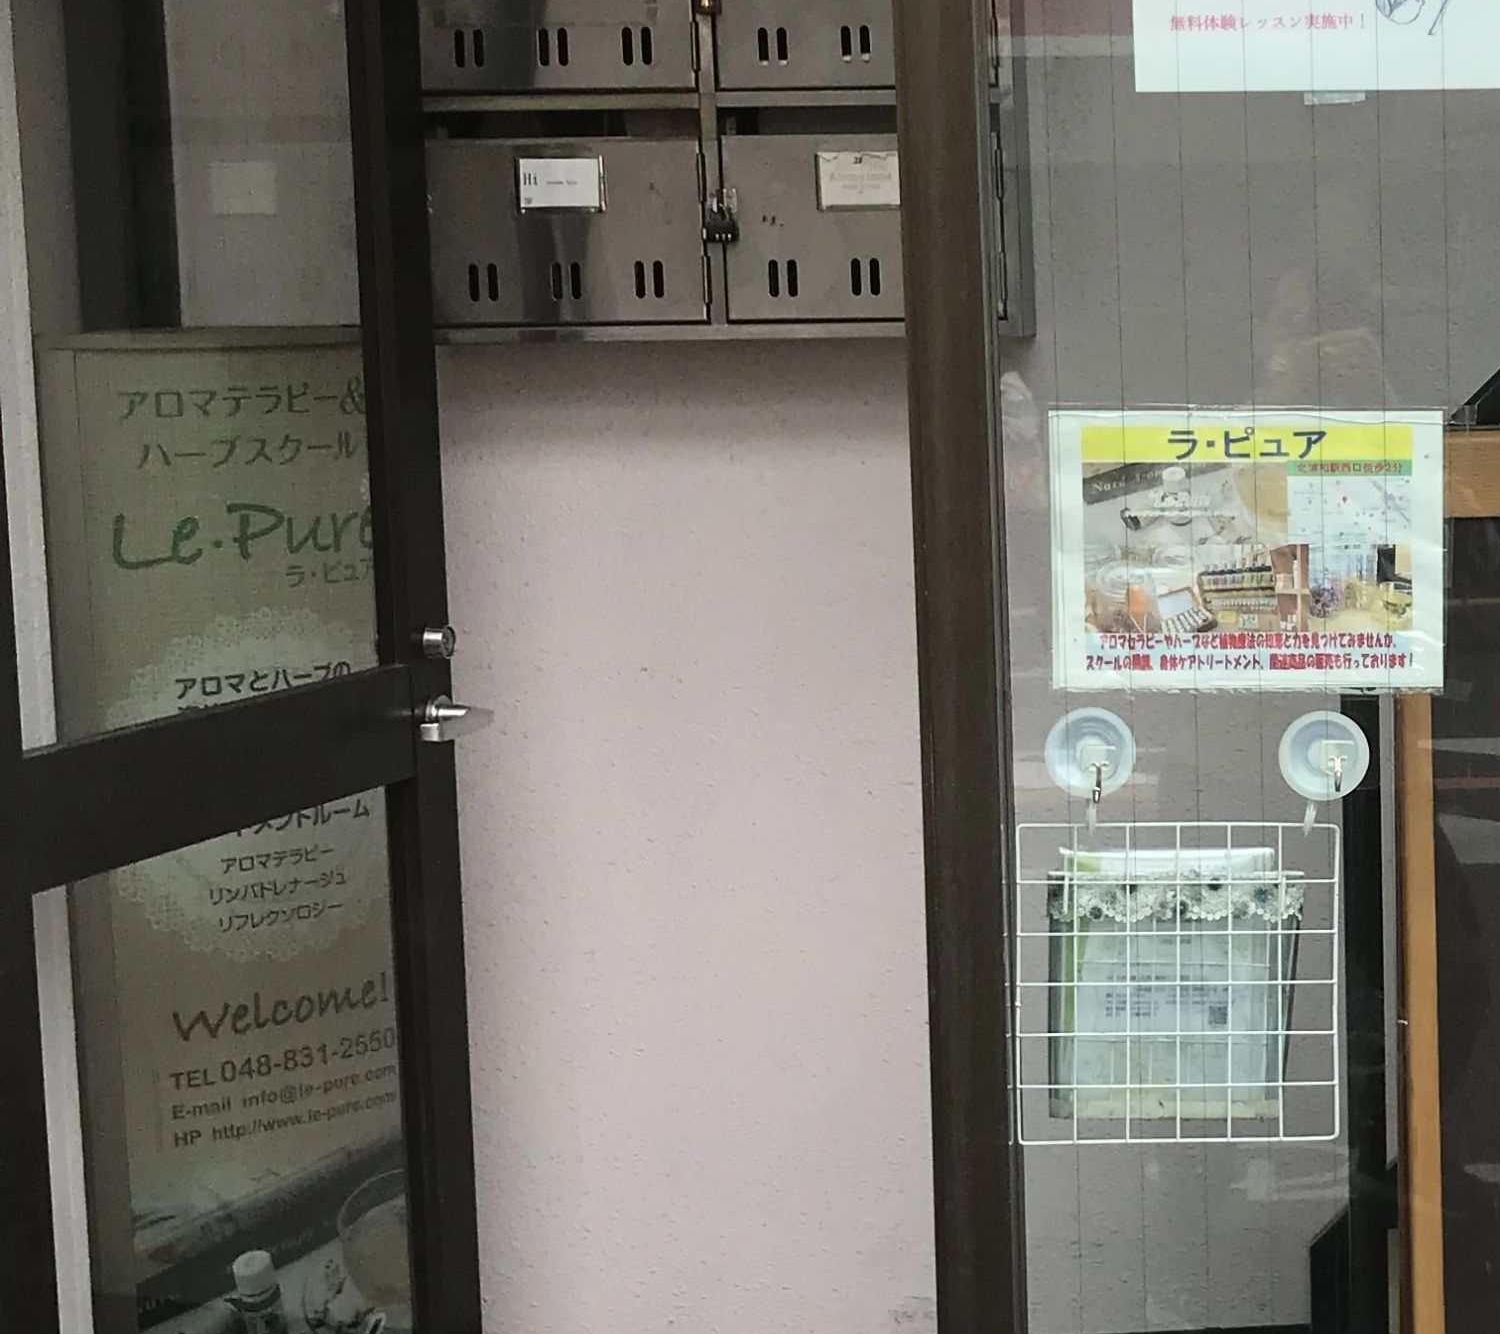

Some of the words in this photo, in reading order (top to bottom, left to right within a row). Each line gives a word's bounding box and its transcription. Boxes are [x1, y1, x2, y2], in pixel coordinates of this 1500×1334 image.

[140, 430, 358, 469] ハーブスクール
[1166, 427, 1327, 459] ラ・ピュア
[220, 844, 334, 875] アロマテラピー
[172, 971, 389, 1042] Welcome!
[170, 1068, 217, 1091] TEL
[220, 1027, 396, 1083] 048-831-2550
[172, 1096, 232, 1120] E-mail
[174, 1129, 202, 1148] HP
